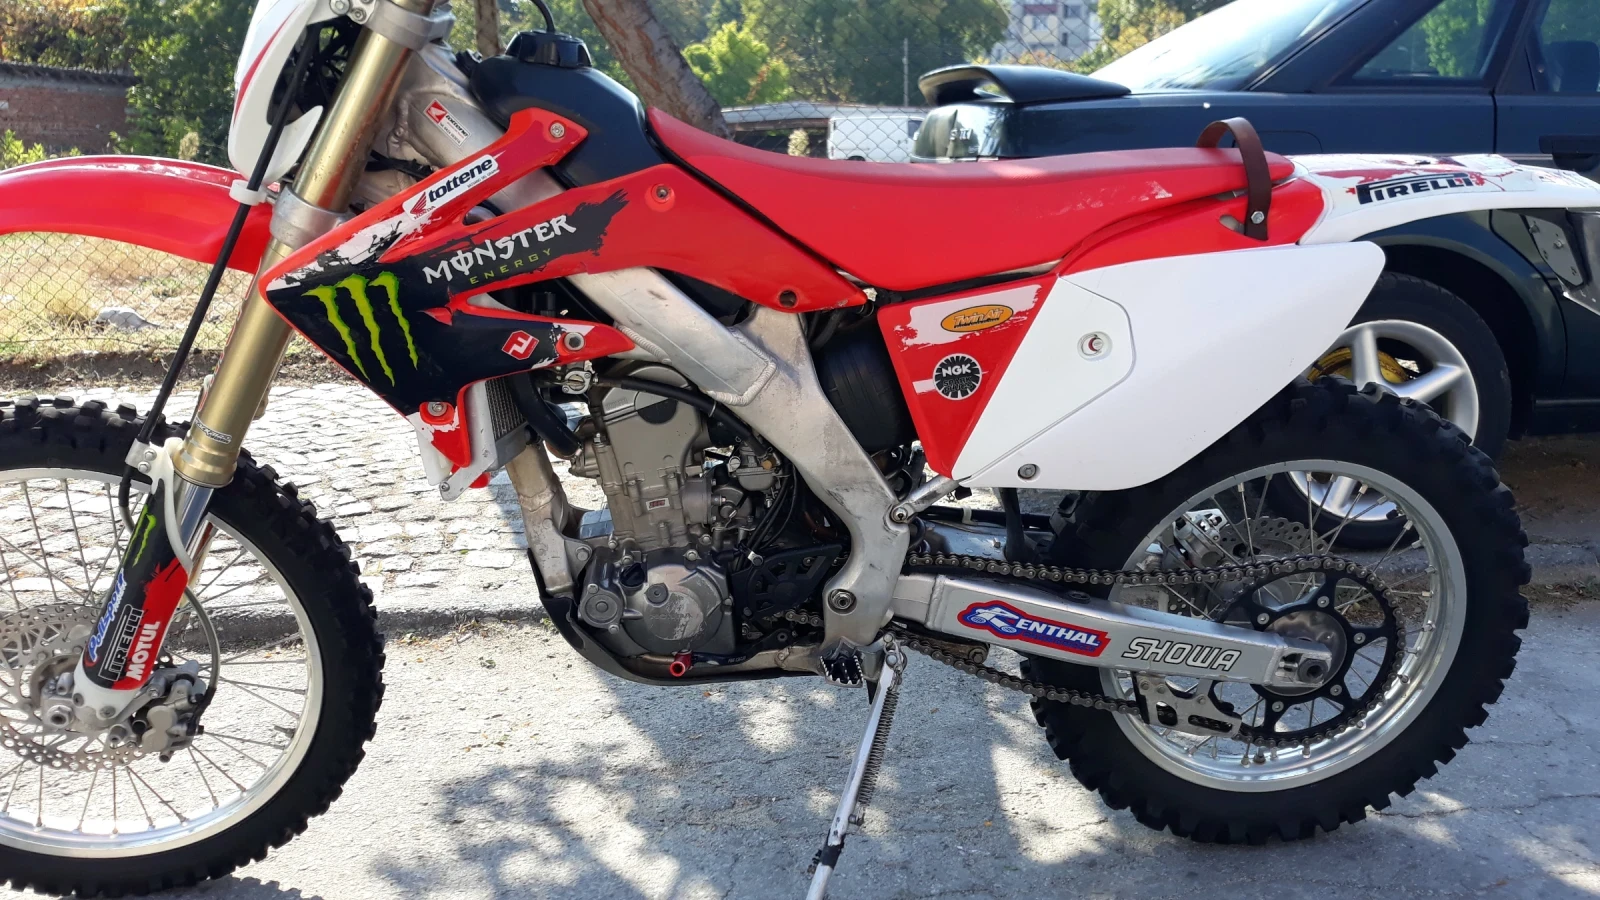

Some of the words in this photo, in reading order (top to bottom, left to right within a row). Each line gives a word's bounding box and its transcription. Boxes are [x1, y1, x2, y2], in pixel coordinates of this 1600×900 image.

[428, 159, 493, 202] tottene
[1355, 172, 1475, 205] PIRELLI
[413, 205, 436, 219] HONDA
[469, 248, 552, 285] ENERGY
[942, 363, 972, 378] NGK
[98, 604, 145, 682] PIRELLI
[126, 621, 161, 682] MOTUL
[1121, 636, 1243, 672] SHOWA
